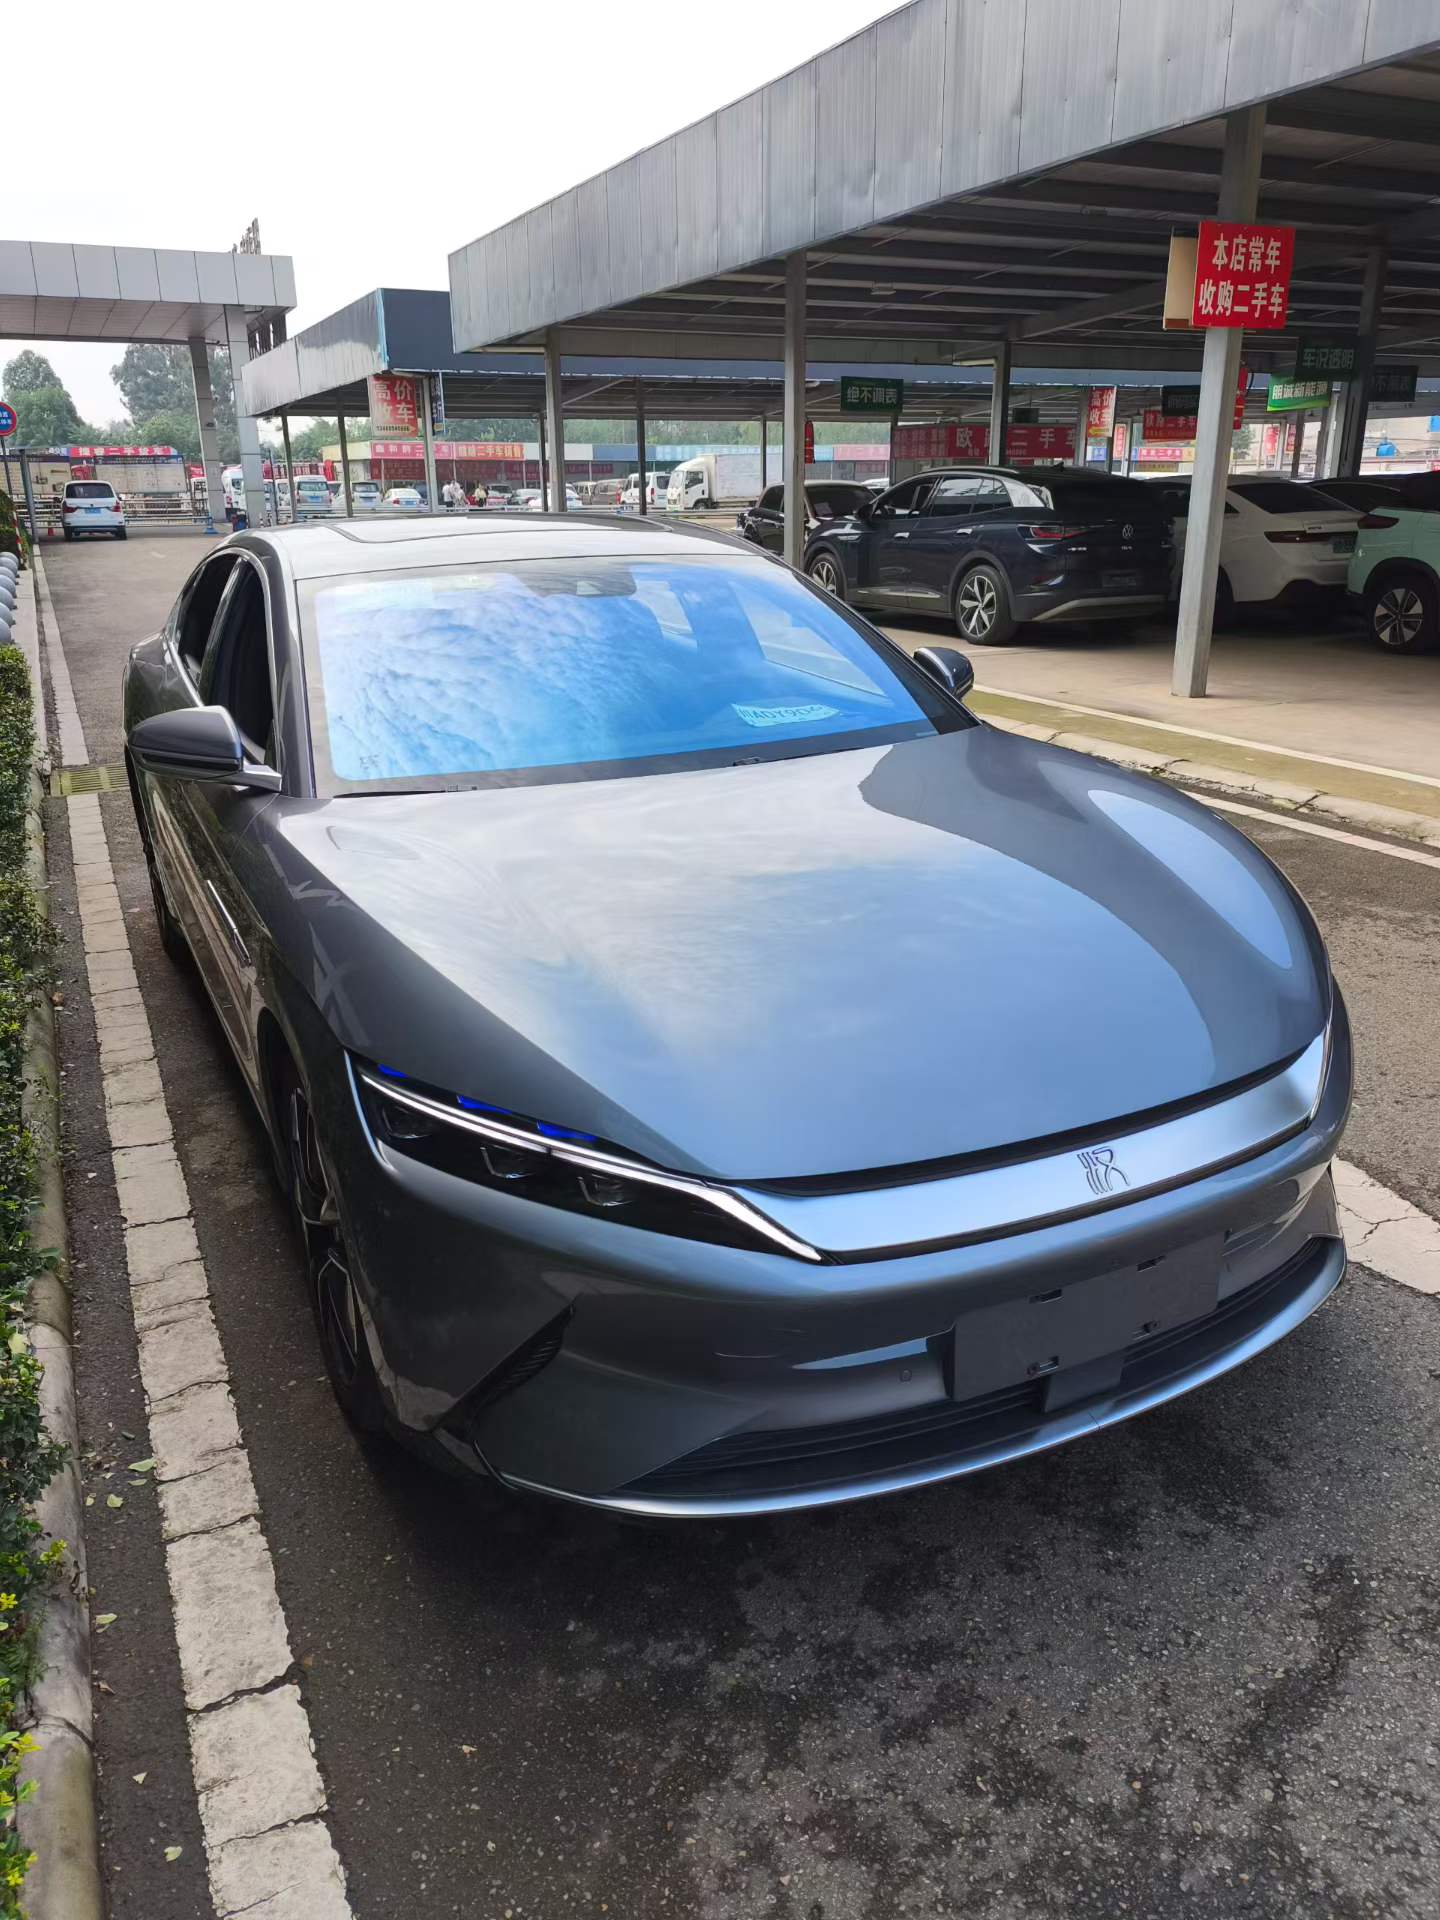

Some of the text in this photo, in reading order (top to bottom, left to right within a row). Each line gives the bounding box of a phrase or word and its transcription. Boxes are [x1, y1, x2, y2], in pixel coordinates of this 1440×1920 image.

[1212, 233, 1281, 274] 本店常年
[1199, 278, 1284, 319] 收购二手车
[1302, 348, 1354, 369] 车况透明
[374, 380, 413, 400] 高价
[1091, 389, 1112, 406] 高价
